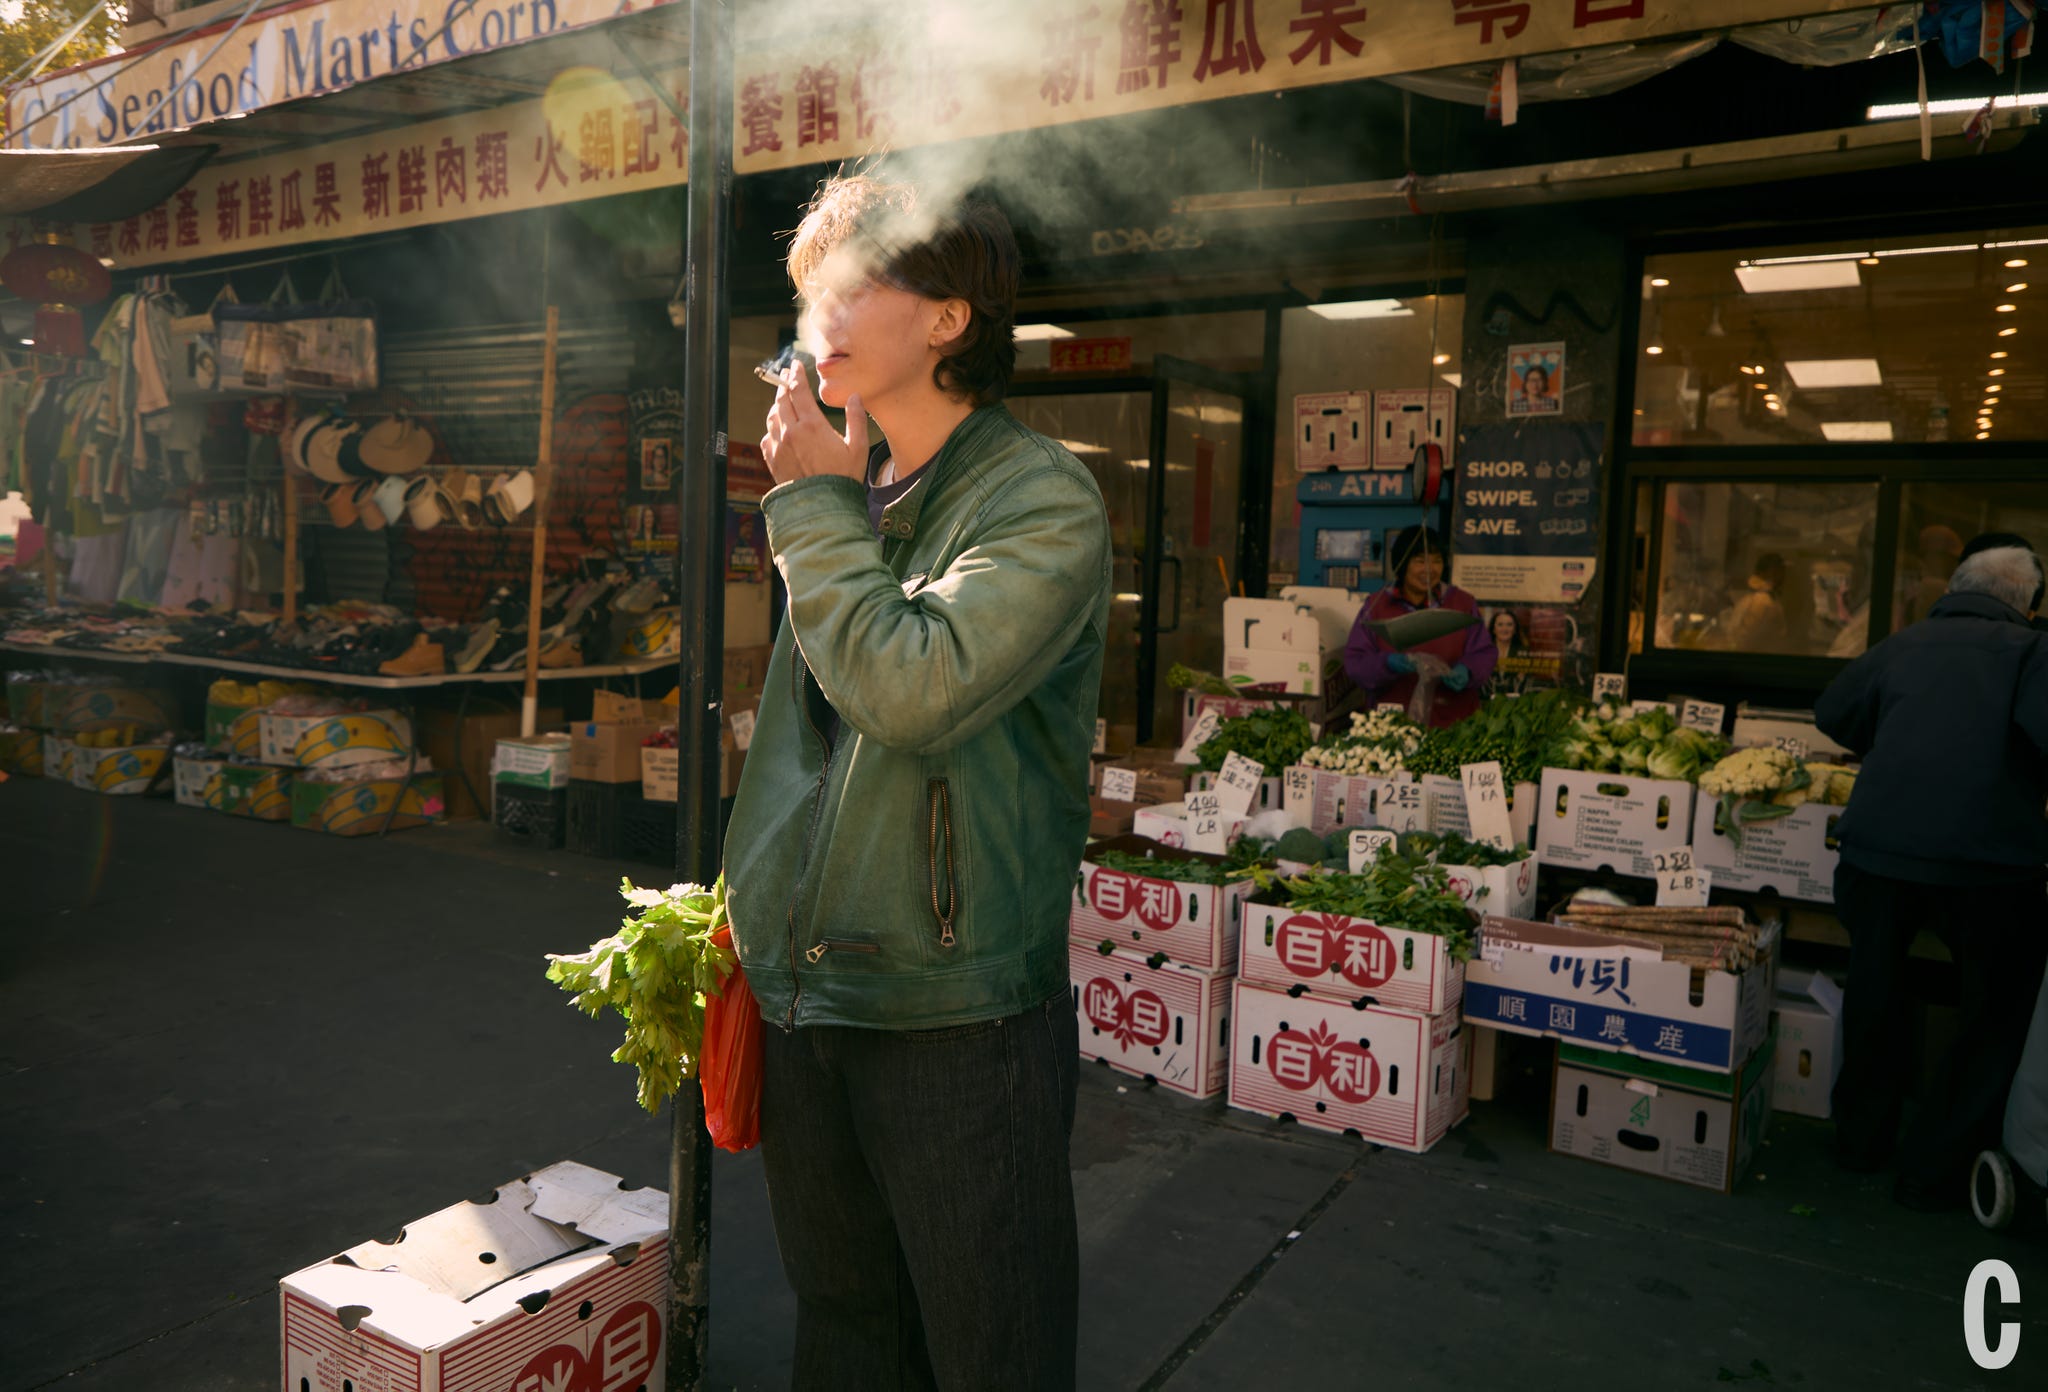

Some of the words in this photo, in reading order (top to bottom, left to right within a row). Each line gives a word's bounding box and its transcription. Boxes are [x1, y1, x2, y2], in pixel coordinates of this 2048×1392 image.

[97, 38, 260, 143] Seafood
[282, 5, 426, 98] Marts
[443, 0, 570, 58] Corp.
[216, 161, 341, 241] 新鮮瓜果
[361, 130, 509, 219] 新鮮肉類
[1467, 461, 1528, 478] SHOP.
[1340, 473, 1404, 497] ATM
[1465, 490, 1538, 507] SWIPE.
[1464, 518, 1521, 536] SAVE.
[1584, 833, 1615, 844] CHINESE
[1616, 838, 1644, 847] CELERY
[1585, 825, 1619, 836] CABBAGE
[1583, 842, 1617, 852] MUSTARD
[1618, 847, 1643, 856] GREEN
[1095, 873, 1176, 924] 百利
[1285, 922, 1387, 980] 百利
[1275, 1035, 1373, 1098] 百利
